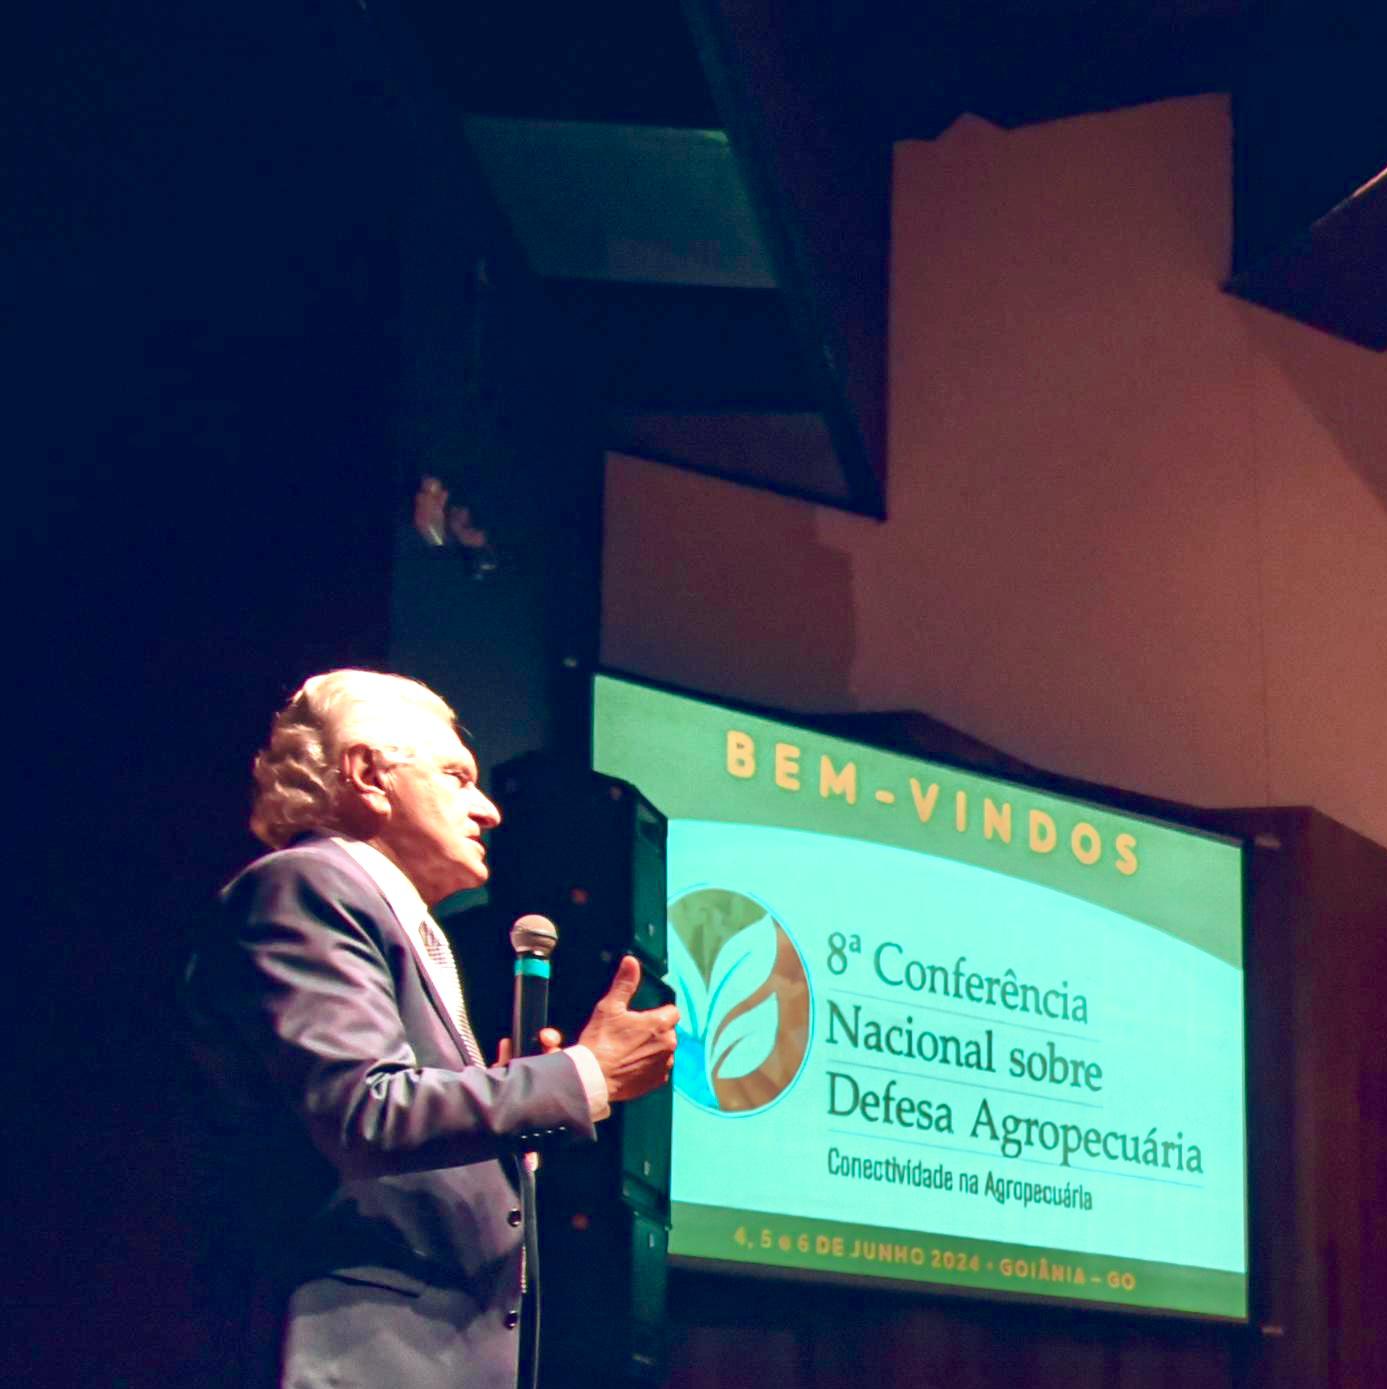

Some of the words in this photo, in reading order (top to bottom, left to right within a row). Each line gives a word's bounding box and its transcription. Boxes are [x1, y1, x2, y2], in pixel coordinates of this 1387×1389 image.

[726, 729, 1139, 876] BEM-VINDOS
[826, 932, 861, 975] 8ª
[873, 941, 1088, 1025] Conferência
[825, 999, 996, 1073] Nacional
[1008, 1041, 1103, 1092] sobre
[826, 1071, 954, 1134] Defesa
[969, 1097, 1204, 1175] Agropecuária
[827, 1147, 953, 1192] Conectividade
[958, 1172, 978, 1195] na
[984, 1170, 1093, 1211] Agropecuária
[734, 1226, 754, 1249] 4,
[760, 1228, 773, 1249] 5
[797, 1233, 810, 1253] 6
[815, 1235, 845, 1257] DE
[849, 1239, 925, 1266] JUNHO
[930, 1249, 980, 1272] 2024
[999, 1257, 1086, 1286] GOIÂNIA
[1106, 1270, 1137, 1292] GO
